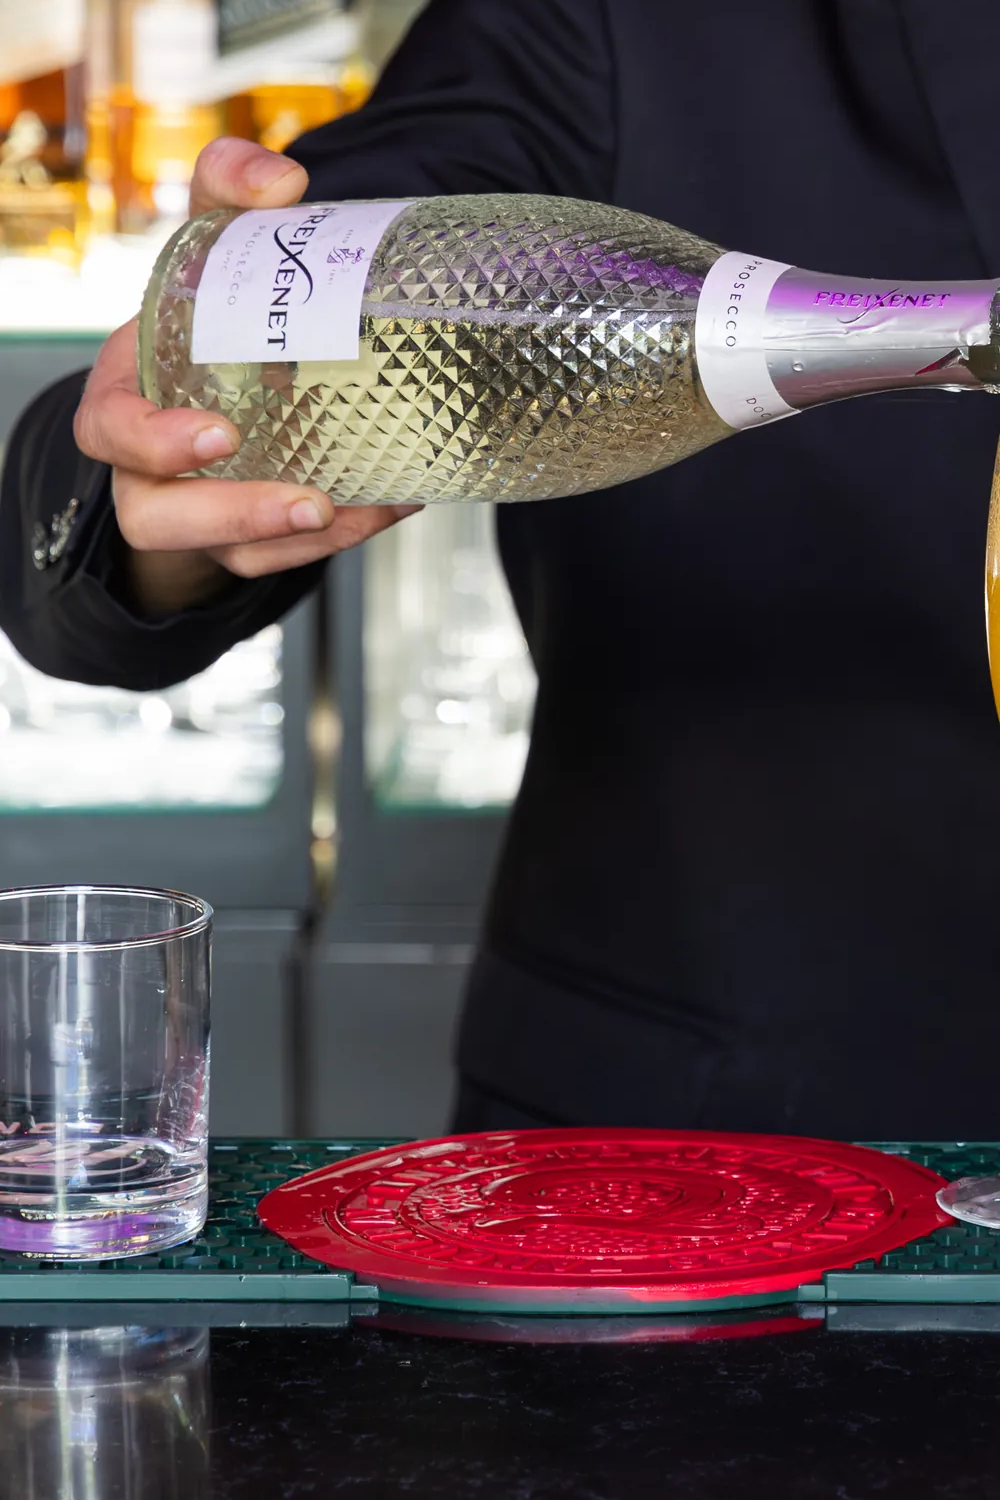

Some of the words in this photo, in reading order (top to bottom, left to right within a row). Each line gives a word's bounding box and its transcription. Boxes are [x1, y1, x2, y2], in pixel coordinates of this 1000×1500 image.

[228, 224, 266, 306] PROSECCO
[267, 207, 337, 352] FREIXENET
[725, 259, 763, 347] PROSECCO
[813, 287, 951, 324] FREIXENET
[746, 397, 772, 419] DOC
